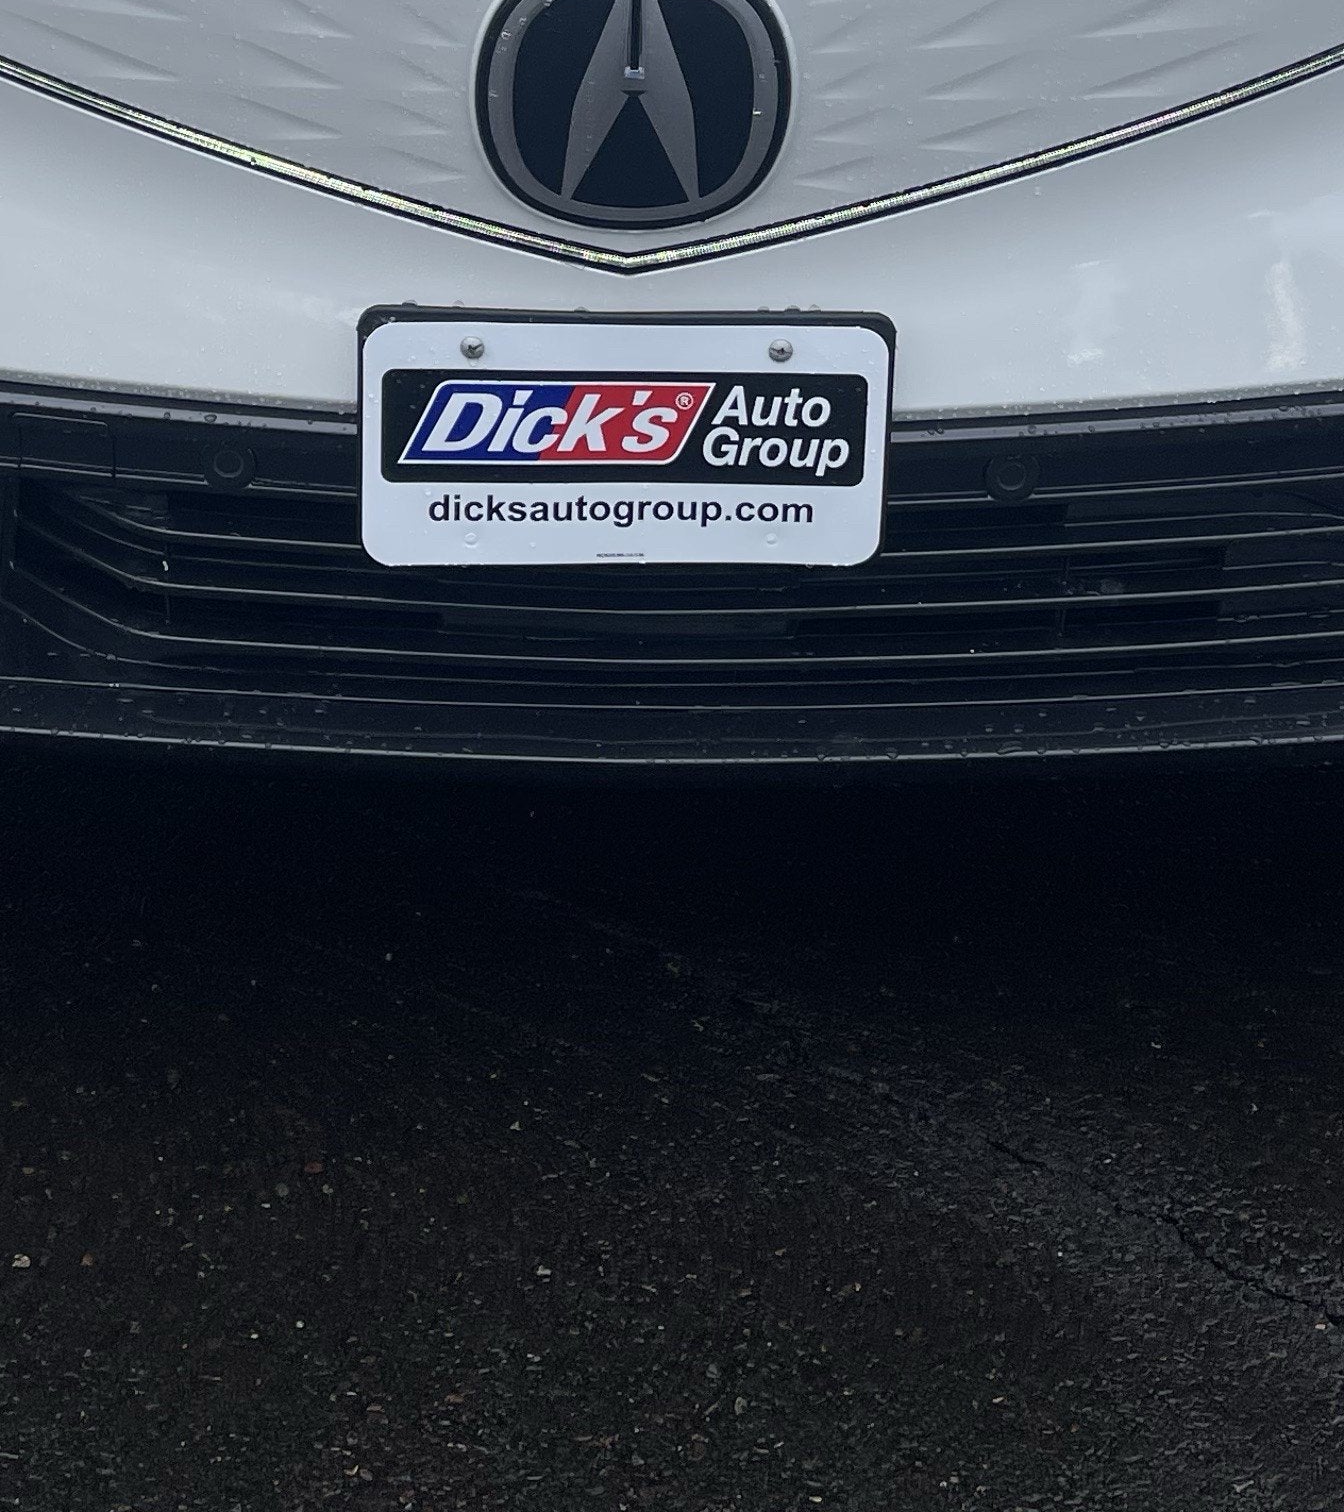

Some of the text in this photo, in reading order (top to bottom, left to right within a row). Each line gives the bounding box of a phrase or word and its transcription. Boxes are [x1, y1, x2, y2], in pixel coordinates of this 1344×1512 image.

[713, 385, 830, 427] Auto
[703, 428, 849, 477] Group
[429, 494, 814, 527] dicksautogroup.com
